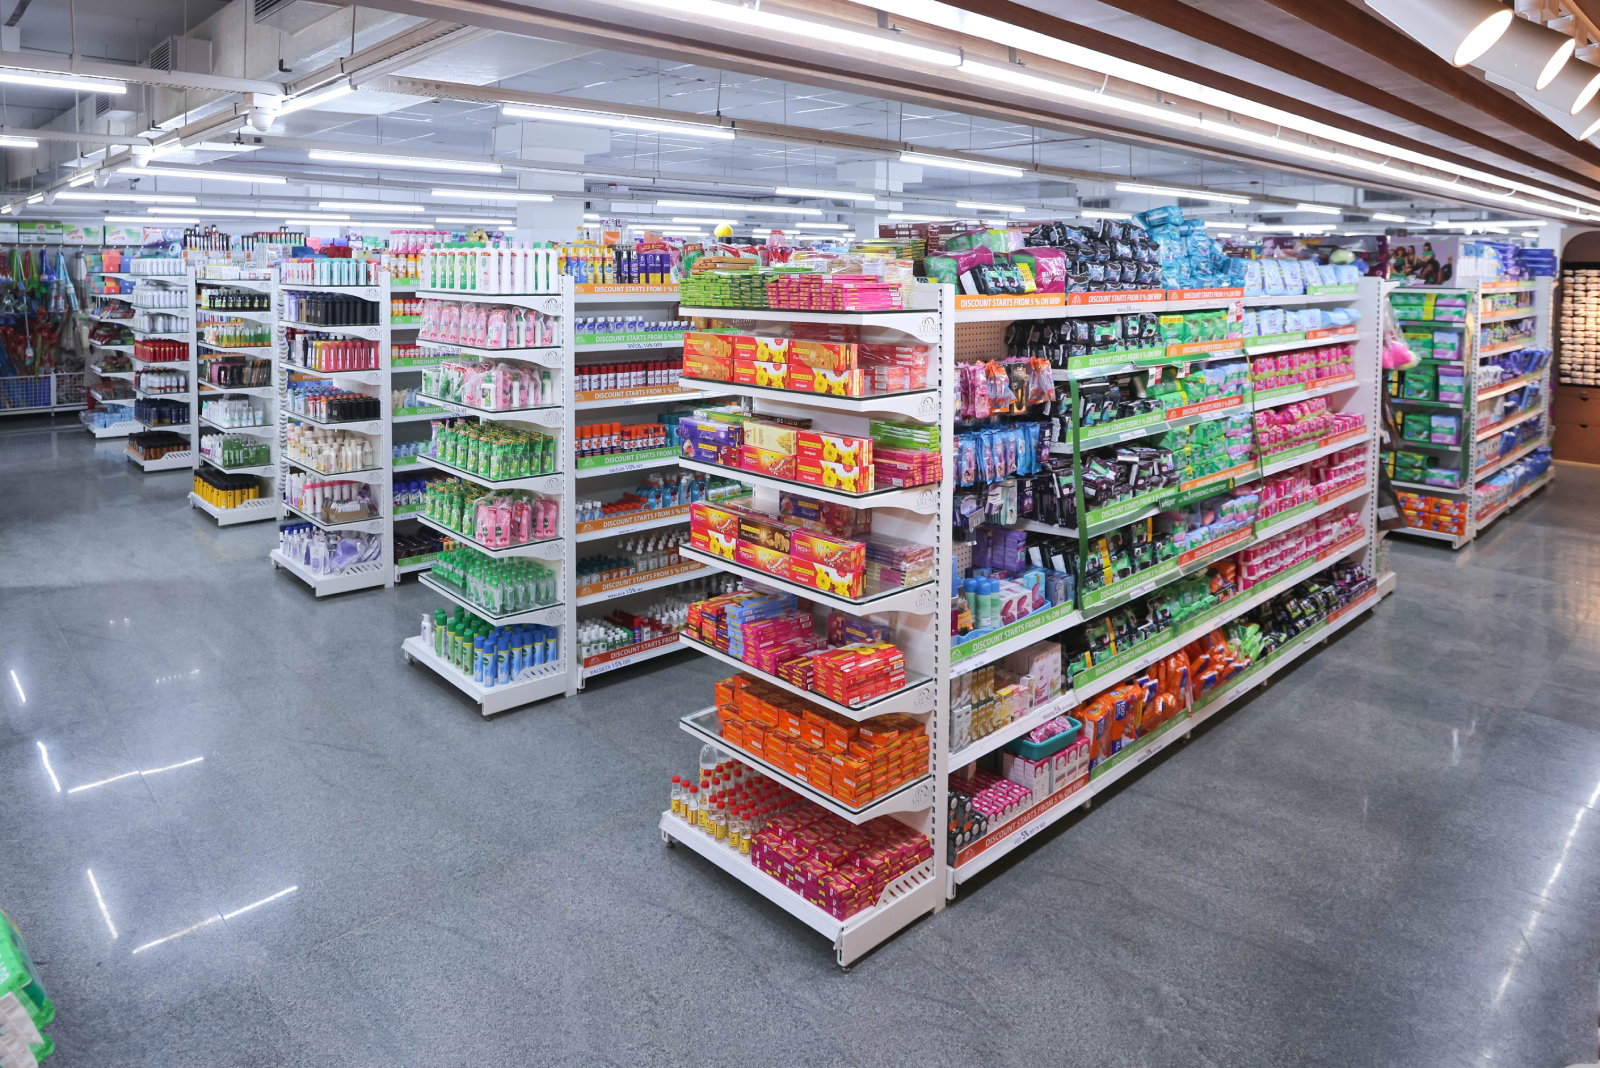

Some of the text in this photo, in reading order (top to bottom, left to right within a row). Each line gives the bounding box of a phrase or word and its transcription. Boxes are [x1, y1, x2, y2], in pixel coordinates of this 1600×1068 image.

[960, 299, 991, 308] DISCOUNT
[992, 298, 1012, 306] STARTS
[604, 456, 634, 464] DISCOUNT
[603, 518, 632, 528] DISCOUNT
[633, 514, 654, 522] STARTS
[654, 510, 670, 519] FROM
[602, 580, 632, 590] DISCOUNT
[632, 575, 652, 584] STARTS
[653, 570, 670, 579] FROM
[972, 633, 1003, 652] DISCOUNT
[1004, 624, 1024, 639] STARTS
[1025, 617, 1041, 631] FROM
[1051, 611, 1058, 619] ON
[1059, 605, 1071, 616] MRP
[610, 635, 678, 659] DISCOUNT STARTS FROM
[985, 822, 1016, 847] DISCOUNT
[1017, 811, 1037, 828] STARTS
[1037, 801, 1053, 814] FROM
[1064, 788, 1072, 797] ON
[1073, 780, 1084, 792] MRP
